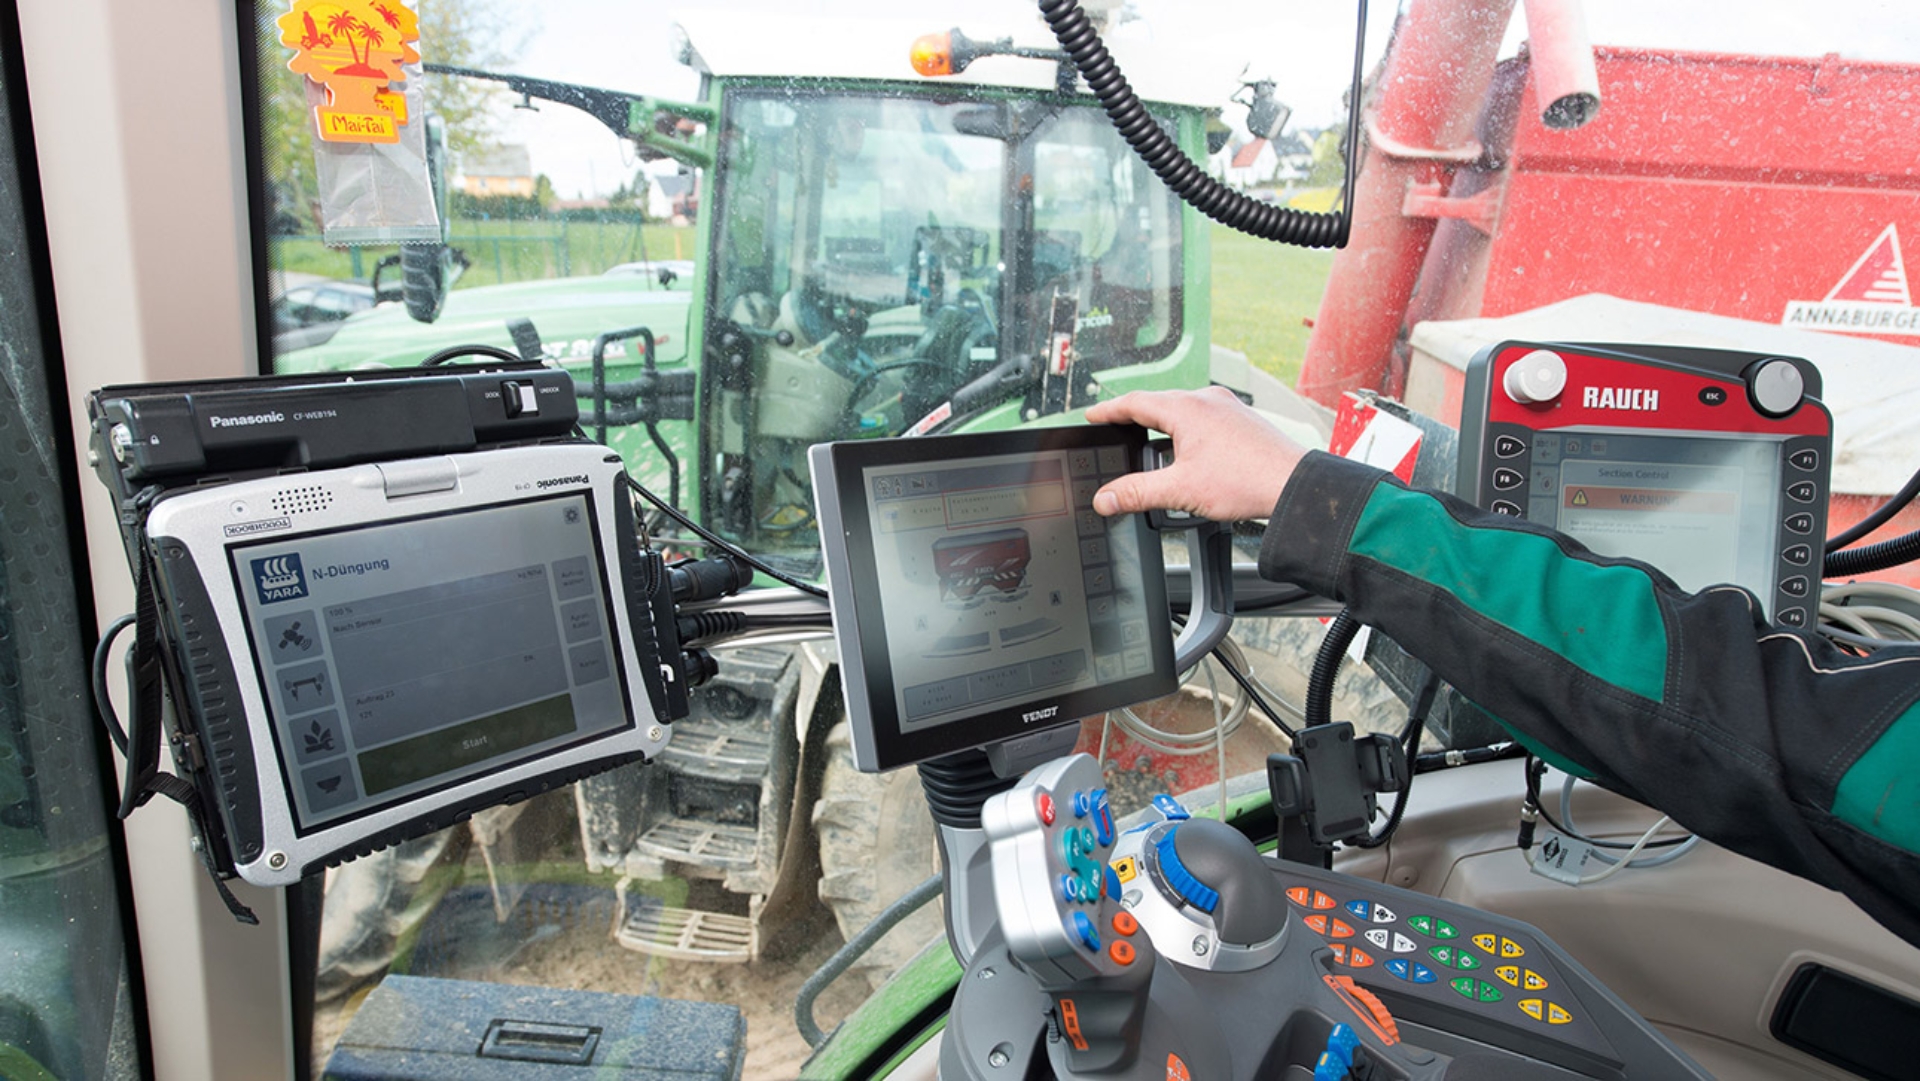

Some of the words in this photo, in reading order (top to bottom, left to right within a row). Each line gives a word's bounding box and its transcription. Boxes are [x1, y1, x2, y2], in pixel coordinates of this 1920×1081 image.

[332, 114, 385, 134] Mai-Tai
[1583, 386, 1659, 411] RAUCH
[210, 411, 285, 428] Panasonic
[1502, 443, 1512, 451] F7
[1803, 456, 1812, 464] F1
[1500, 475, 1510, 483] F8
[1598, 468, 1633, 478] Section
[1635, 470, 1669, 480] Control
[536, 474, 590, 490] Panasonic
[1800, 488, 1810, 496] F2
[226, 520, 289, 534] TOUGHBOOK
[1798, 519, 1807, 527] F3
[1795, 551, 1805, 559] F4
[312, 558, 390, 580] N-Düngung
[264, 586, 302, 600] YARA
[1793, 582, 1802, 590] F5
[1022, 705, 1059, 723] FENDT
[462, 735, 488, 750] Start
